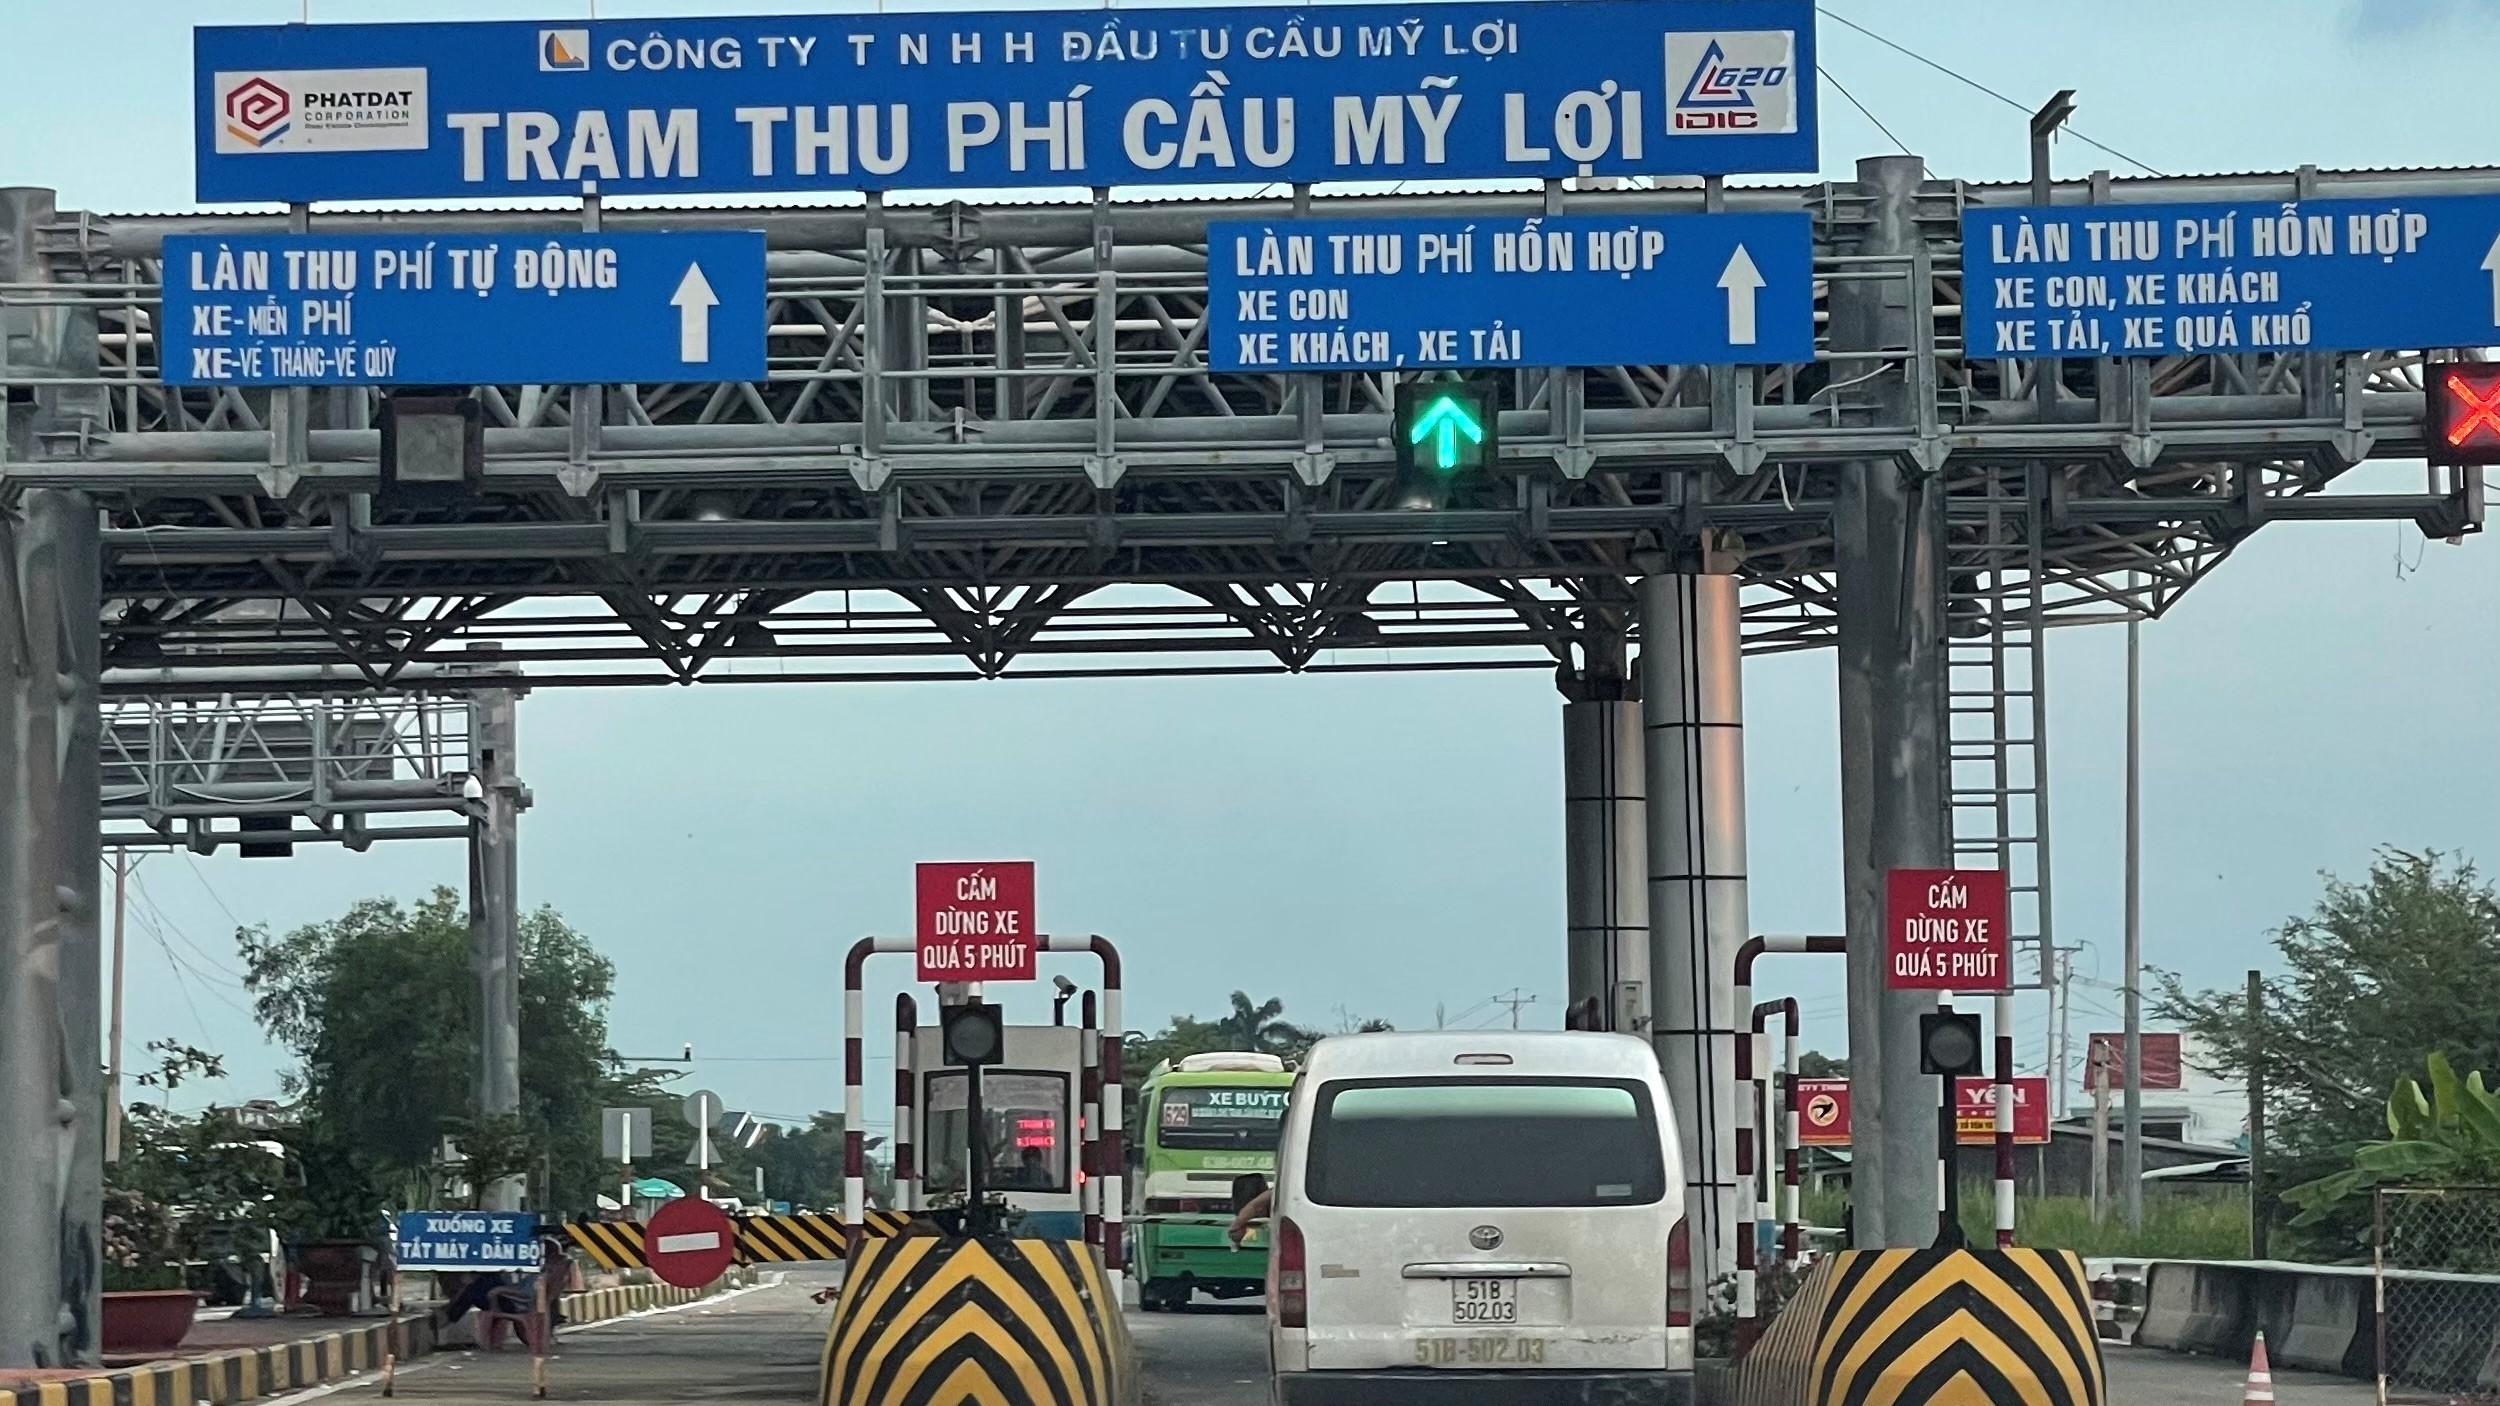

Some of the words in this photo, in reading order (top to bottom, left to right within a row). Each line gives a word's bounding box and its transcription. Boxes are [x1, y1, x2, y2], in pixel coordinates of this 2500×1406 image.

[606, 32, 741, 70] CÔNG
[757, 36, 816, 67] TY
[1063, 17, 1158, 62] ĐẦU
[1245, 16, 1342, 59] CẦU
[1358, 18, 1425, 57] MỸ
[1443, 17, 1518, 62] LỢI
[304, 91, 412, 108] PHATDAT
[304, 110, 409, 121] CORPORATION
[447, 108, 699, 194] TRẠM
[735, 103, 908, 177] THU
[947, 84, 1092, 173] PHÍ
[1122, 70, 1296, 170] CẦU
[1333, 75, 1463, 166] MỸ
[1504, 79, 1643, 178] LỢI
[1236, 228, 1313, 276] LÀN
[1328, 234, 1402, 275] THU
[1418, 224, 1475, 274] PHÍ
[1493, 218, 1574, 272] HỖN
[1588, 225, 1665, 280] HỢP
[1992, 215, 2070, 264] LÀN
[2085, 220, 2160, 262] THU
[2175, 210, 2237, 259] PHÍ
[2252, 202, 2334, 257] HỖN
[2349, 208, 2428, 263] HỢP
[191, 243, 269, 291] LÀN
[283, 250, 357, 291] THU
[374, 241, 436, 290] PHÍ
[447, 244, 498, 297] TỰ
[514, 241, 618, 297] ĐỘNG
[1995, 277, 2035, 309] XE
[2046, 275, 2118, 311] CON,
[2125, 274, 2165, 306] XE
[2177, 266, 2279, 304] KHÁCH
[303, 292, 354, 336] PHÍ
[1238, 290, 1278, 321] XE
[1289, 289, 1349, 321] CON
[1238, 333, 1279, 364] XE
[1418, 330, 1458, 362] XE
[1469, 320, 1521, 361] TẢI
[1996, 320, 2036, 351] XE
[2048, 310, 2110, 353] TẢI,
[2123, 317, 2164, 348] XE
[2175, 310, 2238, 353] QUÁ
[2251, 301, 2312, 346] KHỔ
[957, 868, 996, 901] CẤM
[1928, 875, 1967, 909] CẤM
[936, 905, 989, 935] DỪNG
[994, 910, 1019, 934] XE
[1906, 912, 1959, 943] DỪNG
[1964, 918, 1989, 943] XE
[923, 939, 961, 969] QUÁ
[964, 944, 975, 969] 5
[980, 938, 1027, 968] PHÚT
[1895, 946, 1932, 977] QUÁ
[1936, 953, 1947, 977] 5
[1952, 947, 1999, 977] PHÚT
[1209, 1092, 1233, 1106] XE
[1235, 1090, 1281, 1106] BUÝT
[426, 1213, 486, 1234] XUỐNG
[490, 1219, 514, 1234] XE
[435, 1239, 469, 1259] MÁY
[518, 1240, 541, 1265] BỘ
[1467, 1281, 1501, 1300] 51B
